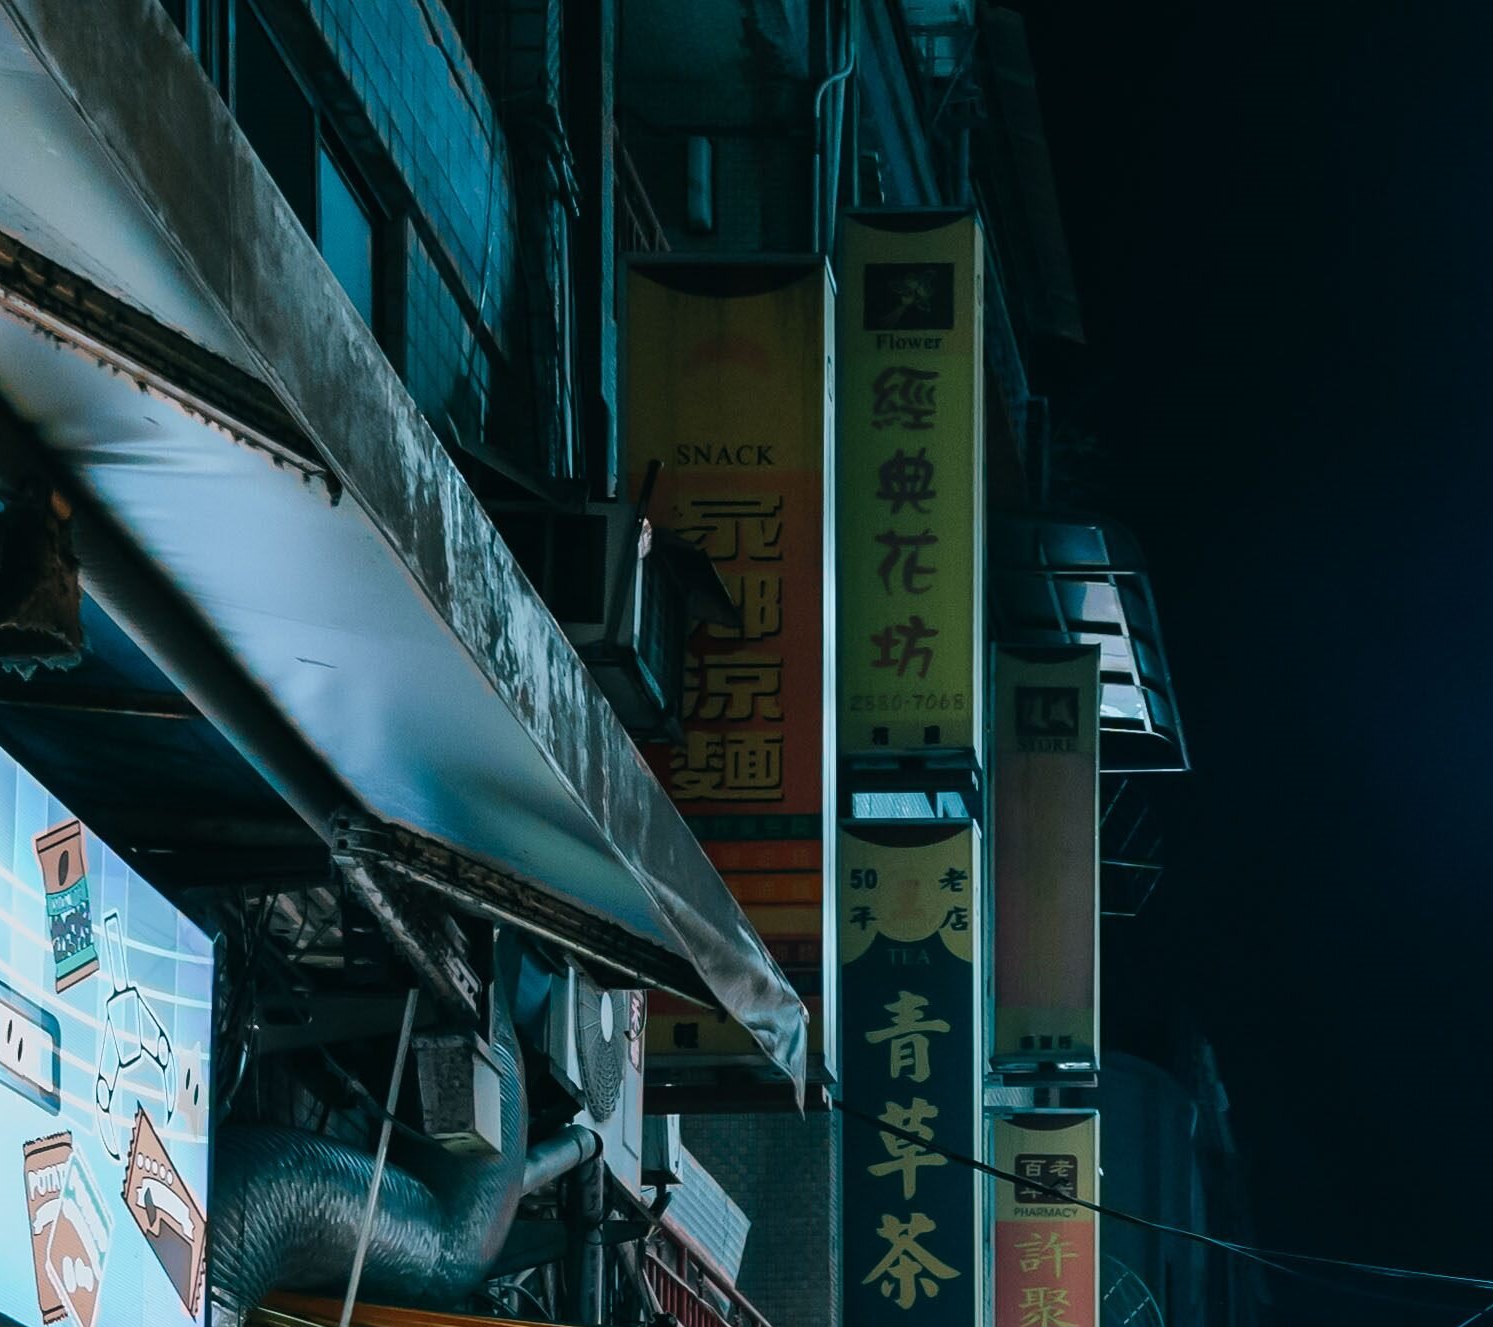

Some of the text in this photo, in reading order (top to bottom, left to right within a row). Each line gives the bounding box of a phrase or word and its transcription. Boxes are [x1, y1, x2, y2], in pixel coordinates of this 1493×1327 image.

[876, 333, 942, 351] Flower
[677, 444, 775, 466] SNACK
[870, 365, 940, 680] 經典花坊
[863, 991, 962, 1311] 青草茶
[1013, 1206, 1079, 1219] PHARMACY
